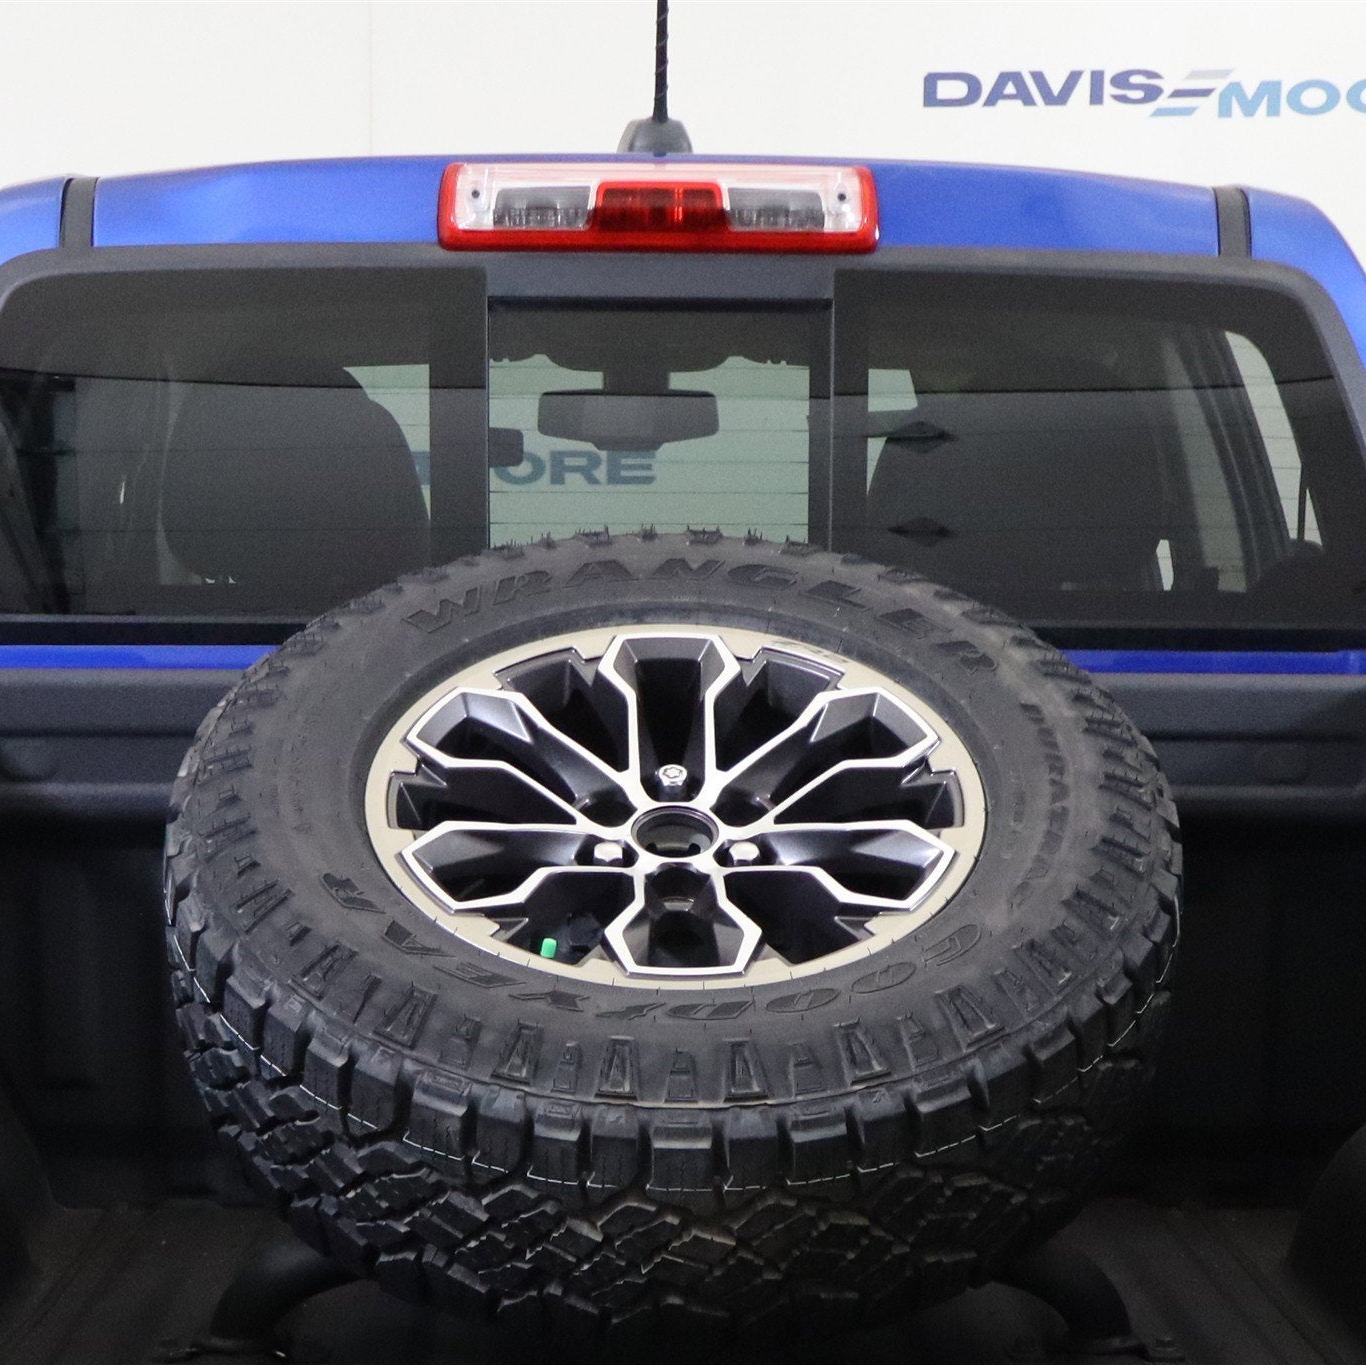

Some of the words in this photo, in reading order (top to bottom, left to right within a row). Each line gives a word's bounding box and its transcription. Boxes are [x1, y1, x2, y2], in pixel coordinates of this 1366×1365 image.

[922, 69, 1166, 108] DAVIS
[492, 449, 657, 486] ORE
[402, 557, 998, 675] WRANGLER
